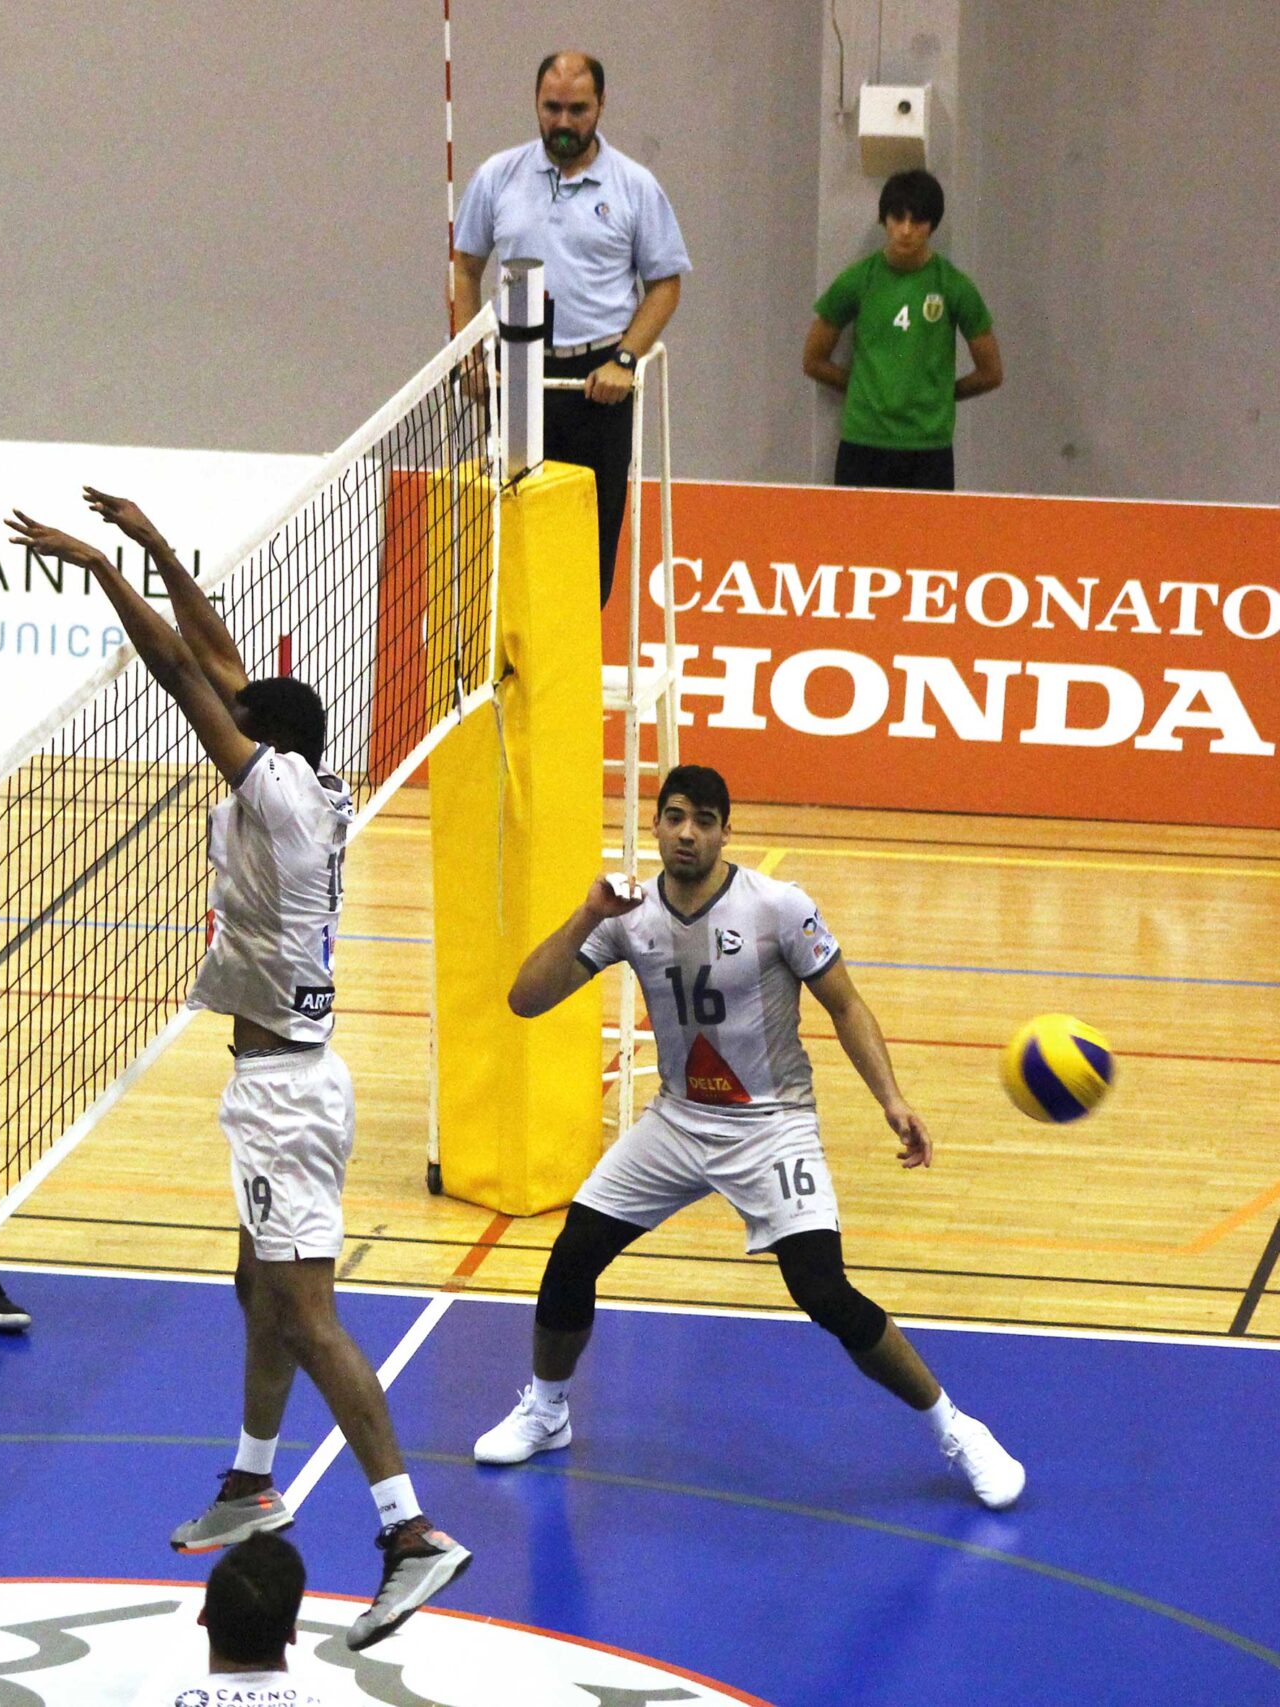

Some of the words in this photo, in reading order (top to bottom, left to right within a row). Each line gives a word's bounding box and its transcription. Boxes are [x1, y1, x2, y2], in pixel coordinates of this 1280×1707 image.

[893, 304, 911, 331] 4
[648, 556, 1280, 642] CAMPEONATO
[640, 641, 1276, 756] HONDA
[665, 965, 727, 1026] 16
[688, 1076, 733, 1091] DELTA
[243, 1175, 273, 1225] 19
[773, 1158, 816, 1200] 16
[216, 1688, 297, 1703] CASINO
